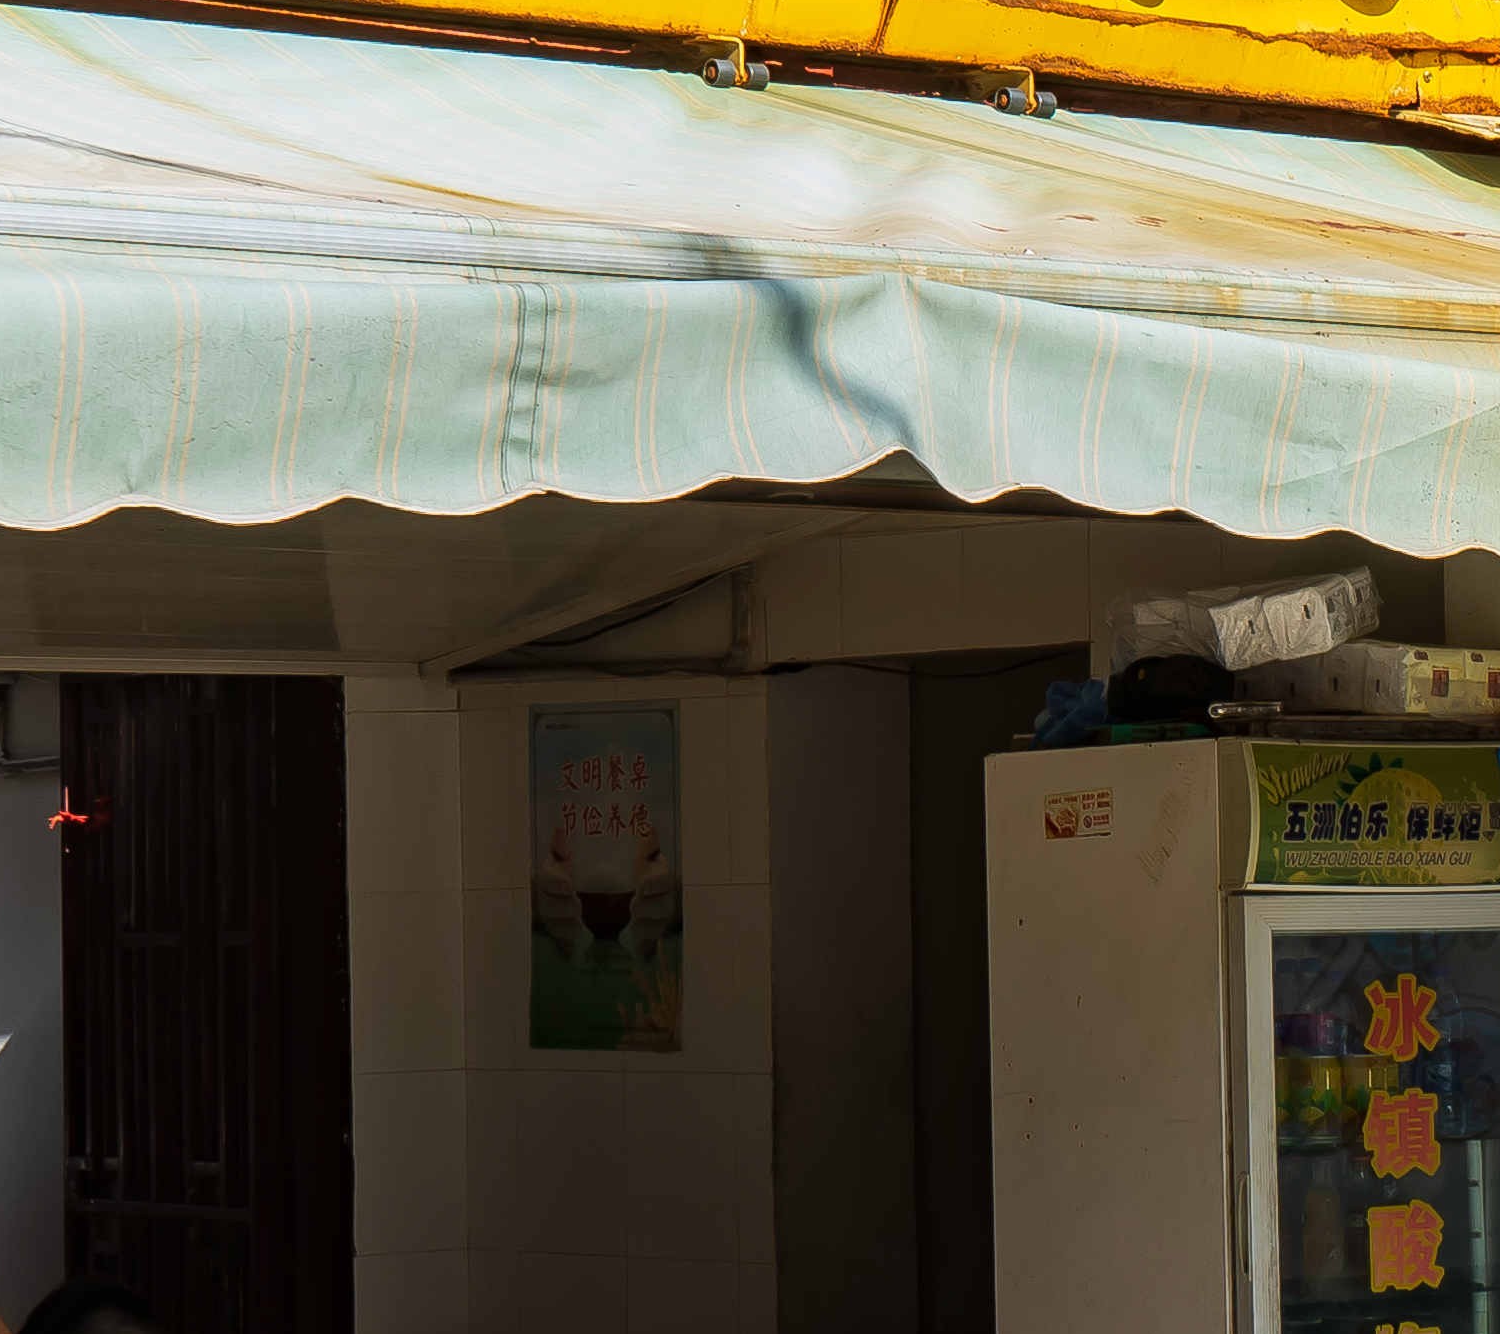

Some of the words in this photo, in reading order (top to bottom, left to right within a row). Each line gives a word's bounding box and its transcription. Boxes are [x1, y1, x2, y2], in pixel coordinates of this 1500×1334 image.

[556, 754, 651, 793] 文明餐桌
[560, 801, 653, 841] 节俭养德
[1284, 802, 1389, 843] 五洲伯乐
[1406, 802, 1483, 842] 保鲜柜
[1350, 850, 1383, 866] BOLE
[1386, 850, 1413, 866] BAO
[1417, 849, 1446, 866] XIAN
[1449, 849, 1472, 866] GUI
